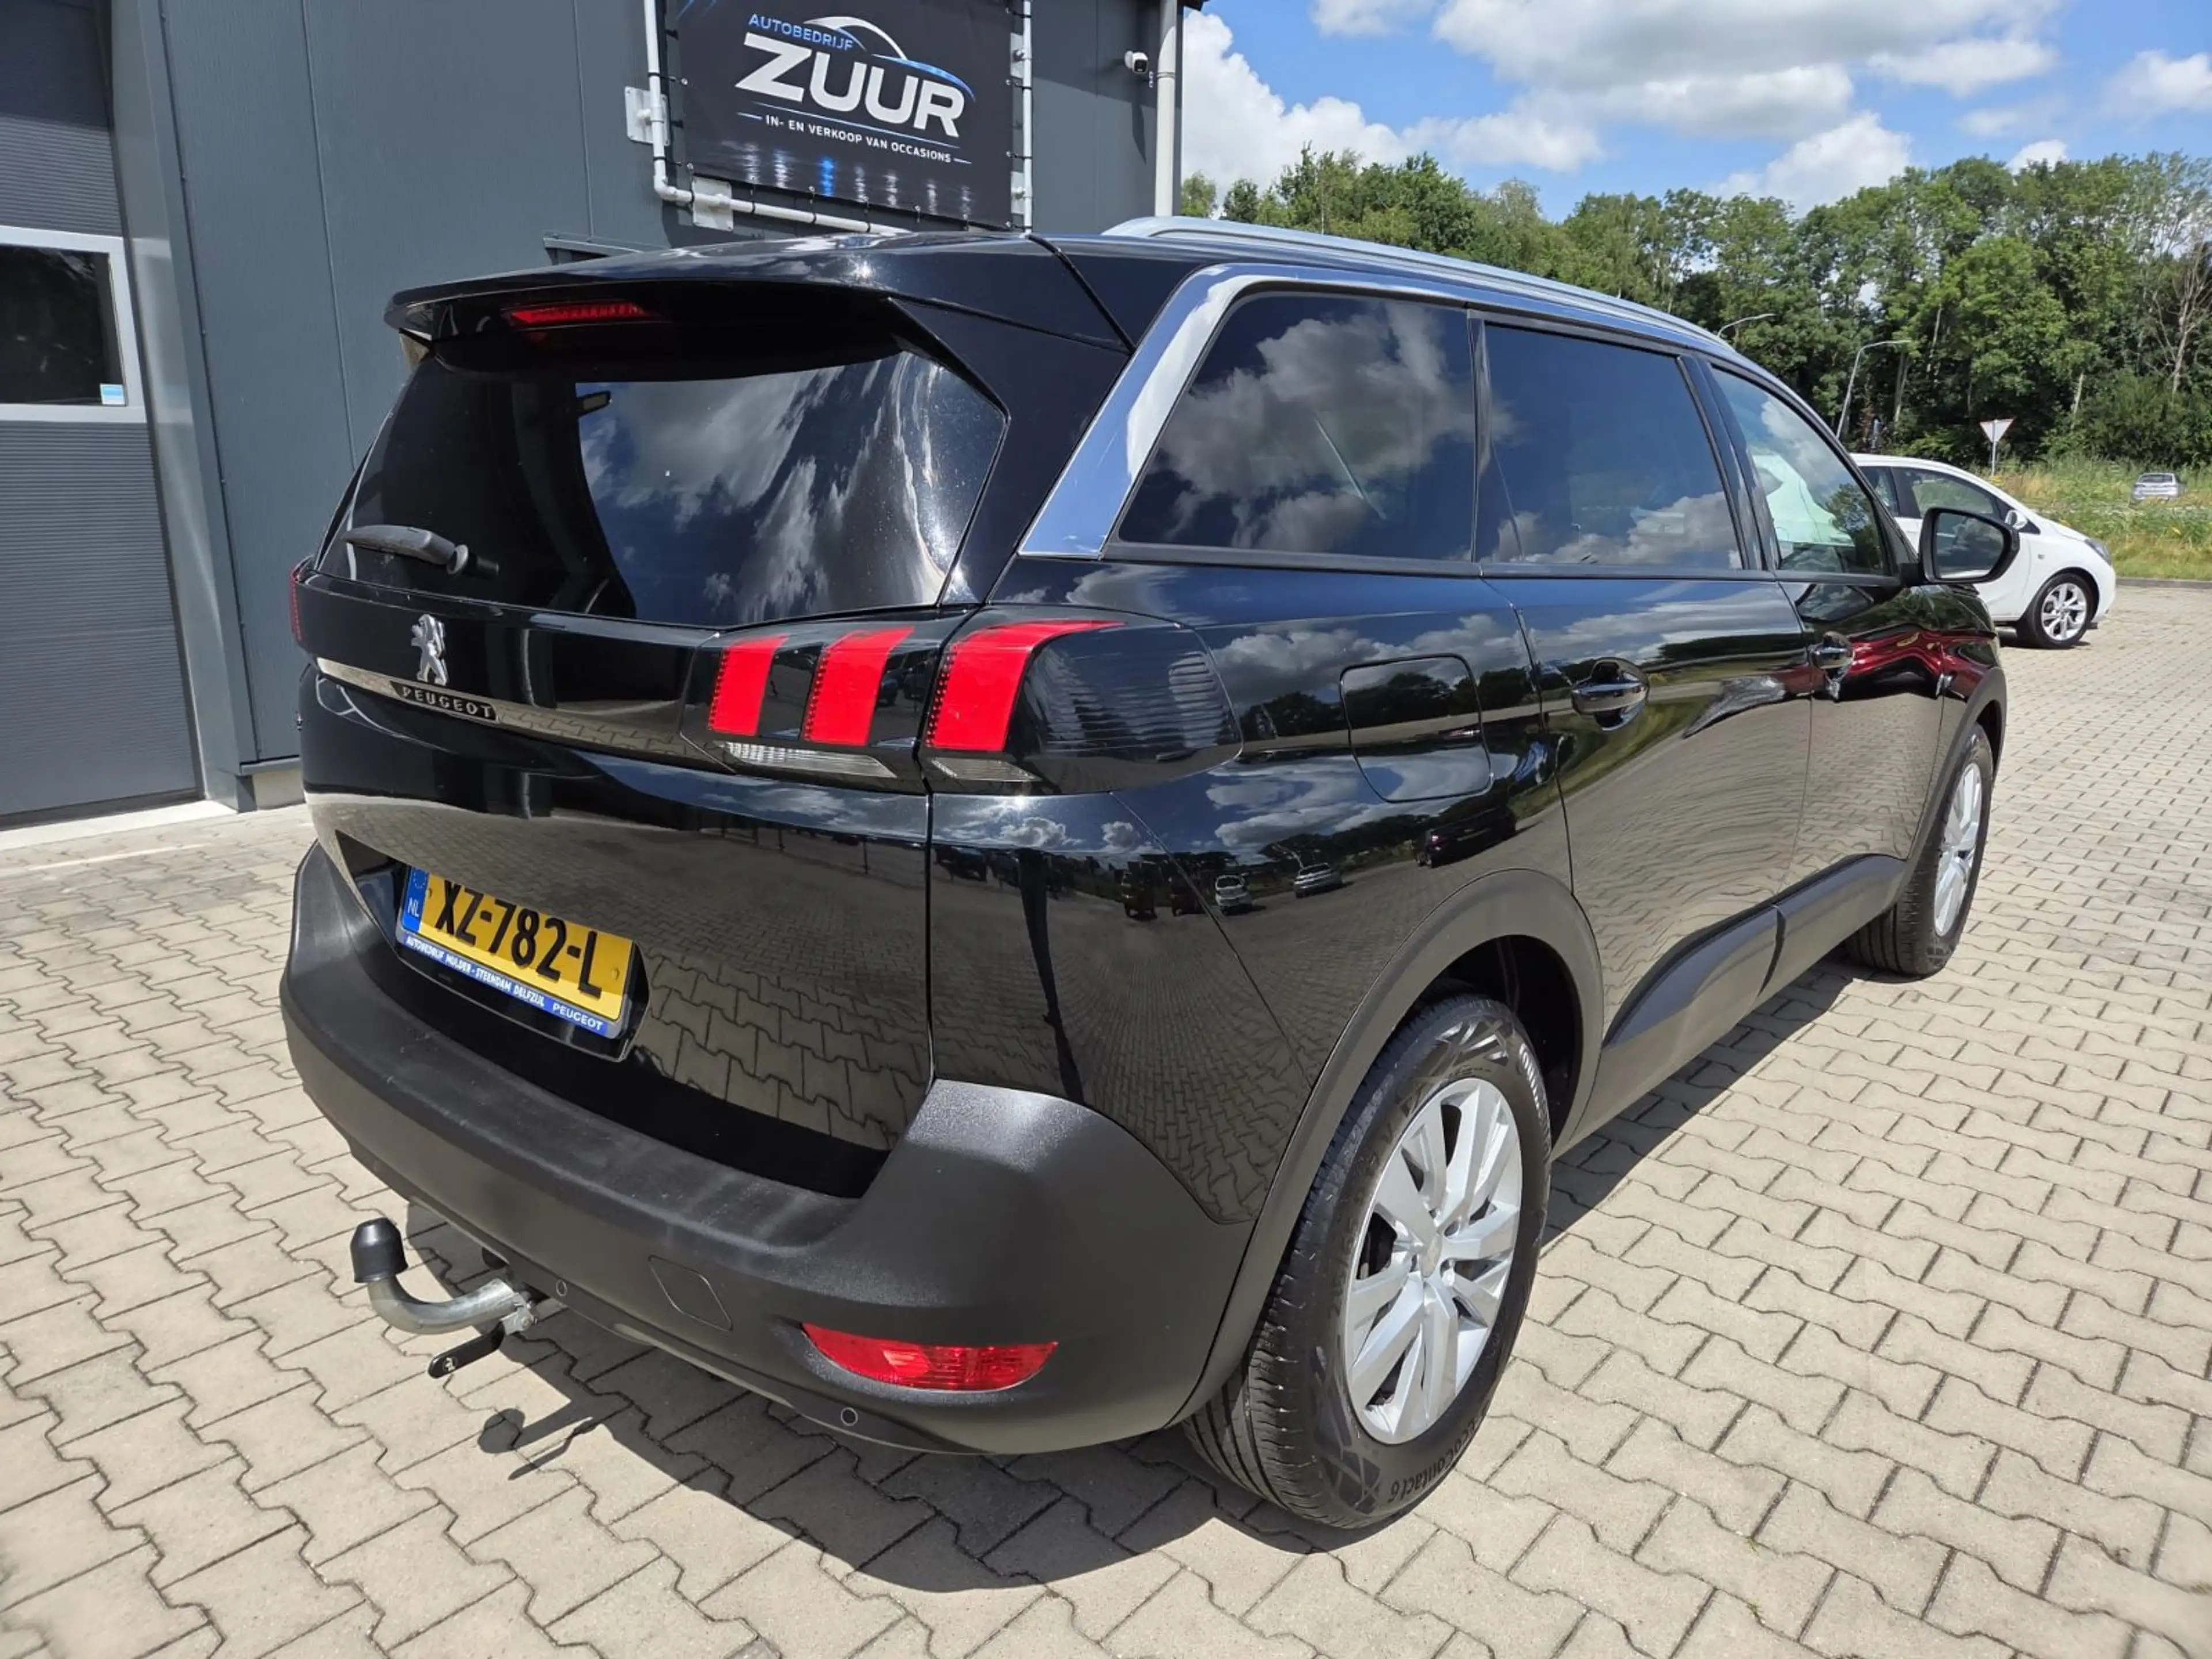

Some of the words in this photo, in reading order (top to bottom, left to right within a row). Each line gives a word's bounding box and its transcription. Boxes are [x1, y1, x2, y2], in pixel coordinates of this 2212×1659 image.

[748, 13, 854, 52] AUTOBEDRIJF
[735, 32, 966, 138] ZUUR
[766, 115, 785, 127] IN-
[788, 120, 805, 132] EN
[808, 123, 862, 144] VERKOOP
[866, 137, 888, 149] VAN
[891, 142, 952, 163] OCCASIONS
[402, 685, 492, 717] PEUGEOT
[407, 897, 420, 918] NL
[435, 879, 602, 999] XZ-782-L
[552, 1002, 604, 1031] PEUGEOT
